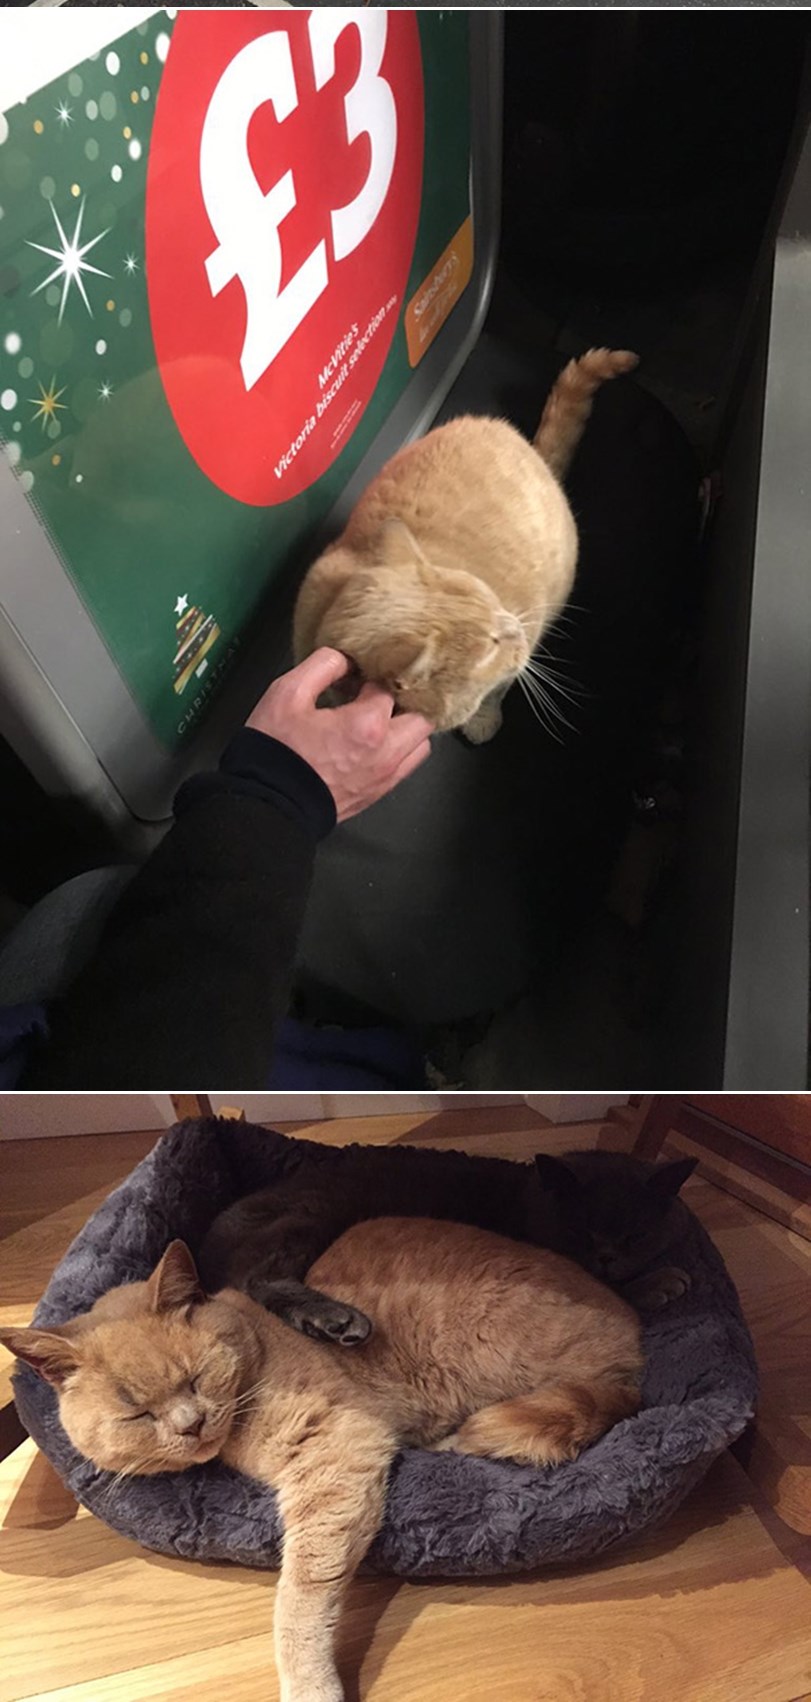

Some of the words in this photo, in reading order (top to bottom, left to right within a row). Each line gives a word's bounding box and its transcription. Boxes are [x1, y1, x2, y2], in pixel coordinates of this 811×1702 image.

[199, 10, 397, 393] £3
[273, 415, 317, 480] Victoria
[315, 366, 350, 418] biscuit
[348, 306, 387, 370] selection
[317, 322, 359, 389] McVitie's
